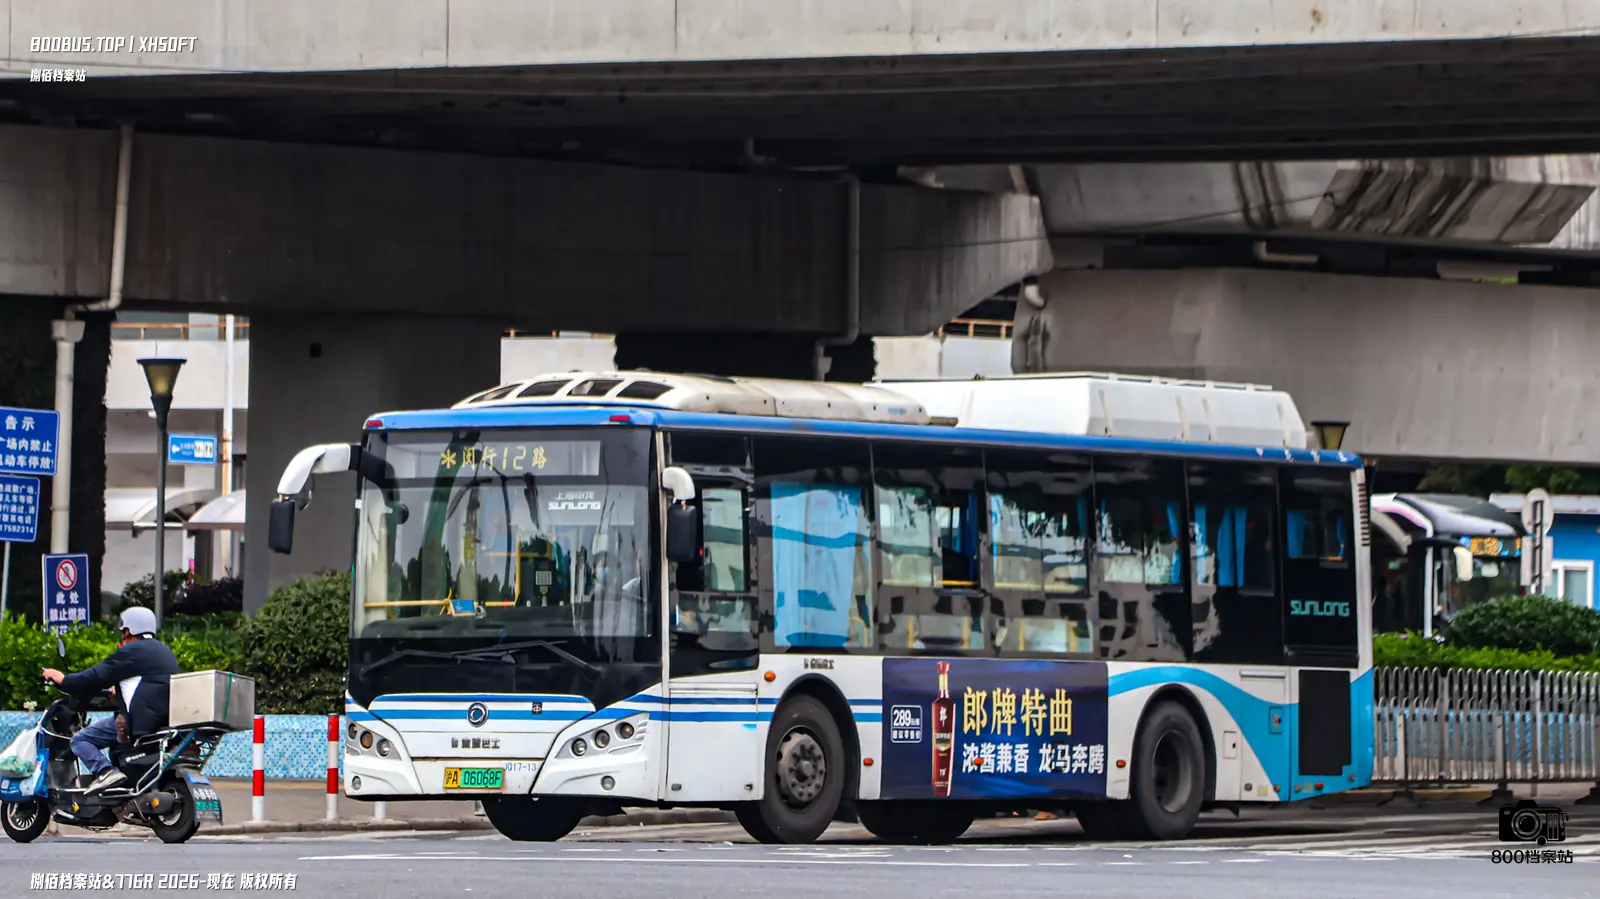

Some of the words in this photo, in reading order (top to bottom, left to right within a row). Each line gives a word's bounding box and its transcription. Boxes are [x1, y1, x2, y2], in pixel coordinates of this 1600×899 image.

[5, 414, 35, 431] 告示
[0, 454, 54, 470] 动车停放!
[1290, 600, 1350, 617] SUNLONG
[962, 686, 1073, 737] 郎牌特曲
[961, 743, 1030, 774] 浓酱兼香
[1038, 743, 1105, 775] 龙马奔腾
